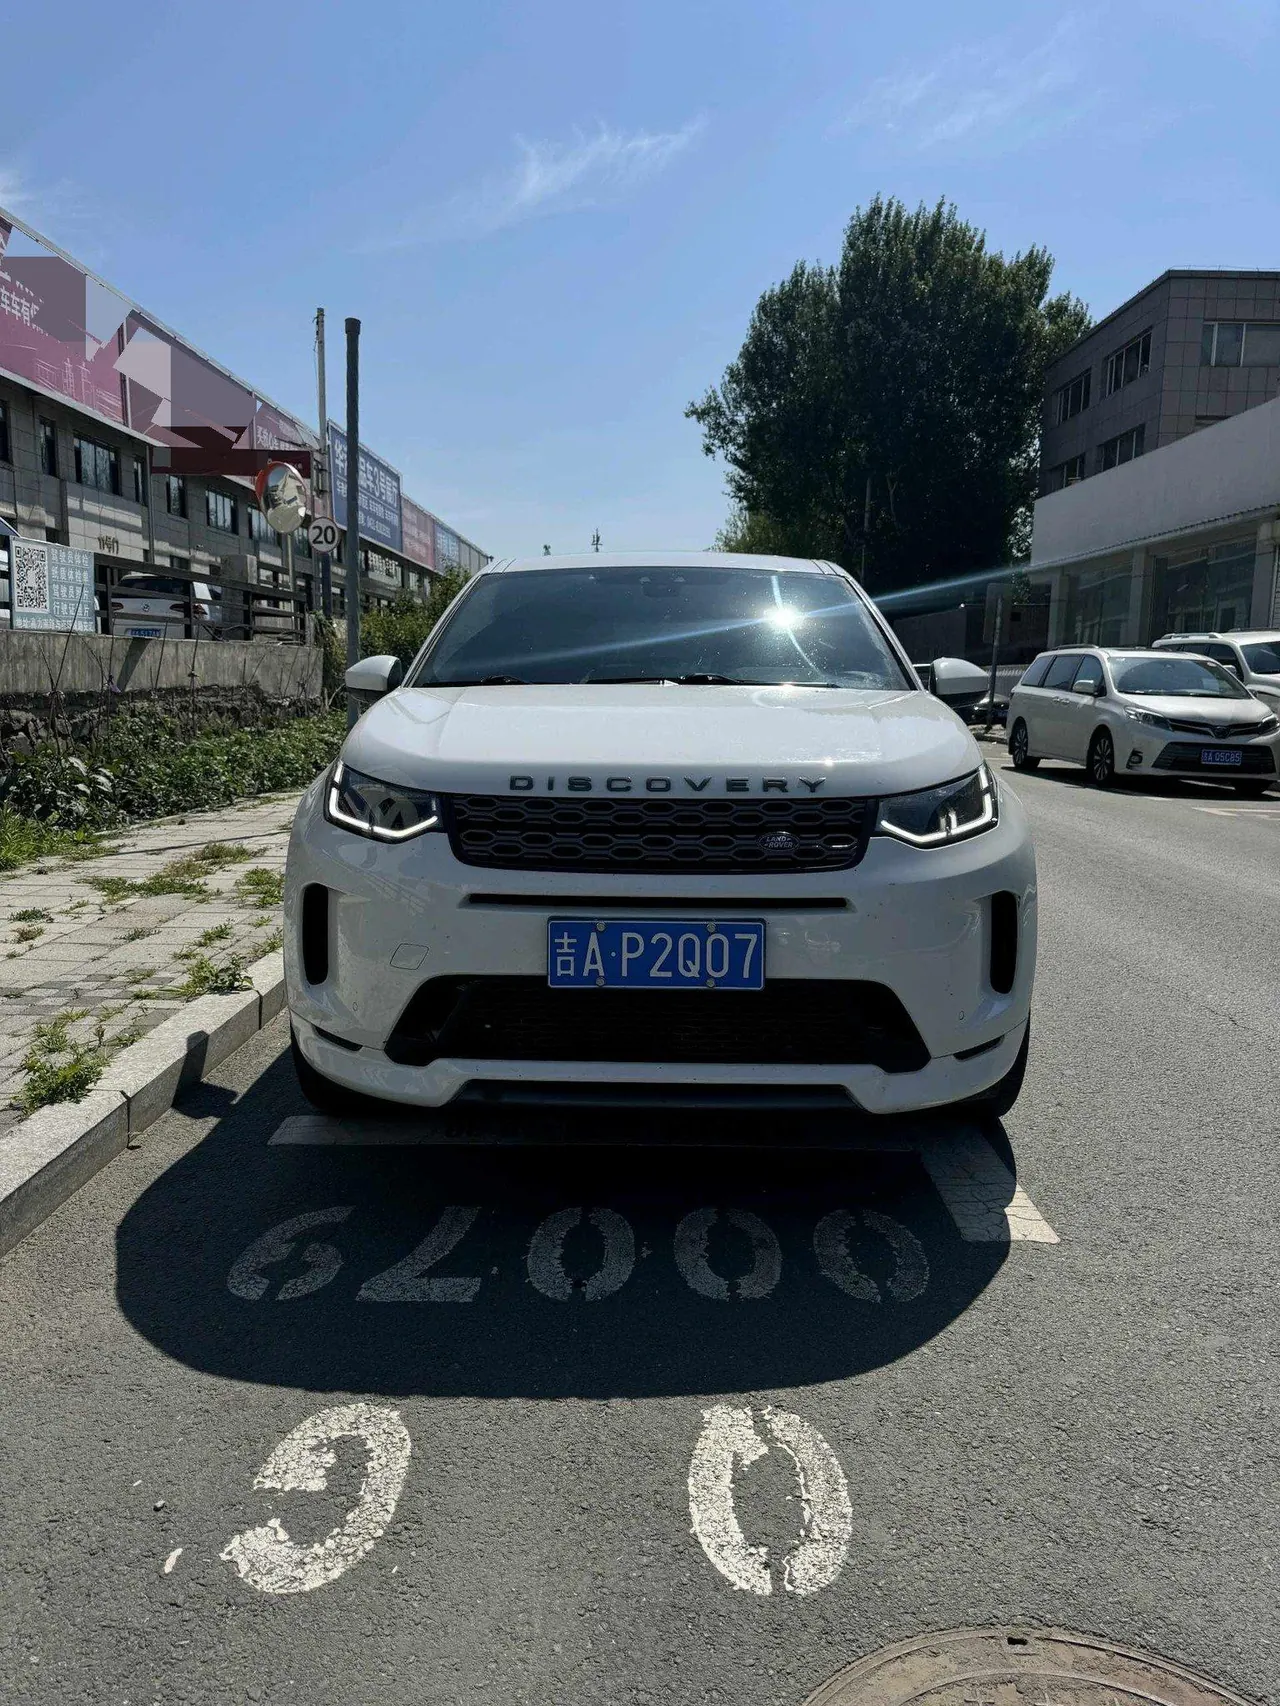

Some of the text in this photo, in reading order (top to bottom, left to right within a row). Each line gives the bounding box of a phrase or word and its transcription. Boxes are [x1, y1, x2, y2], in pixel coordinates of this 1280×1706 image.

[312, 525, 336, 545] 20
[509, 775, 827, 793] DISCOVERY
[554, 931, 759, 978] 吉A·P2Q07
